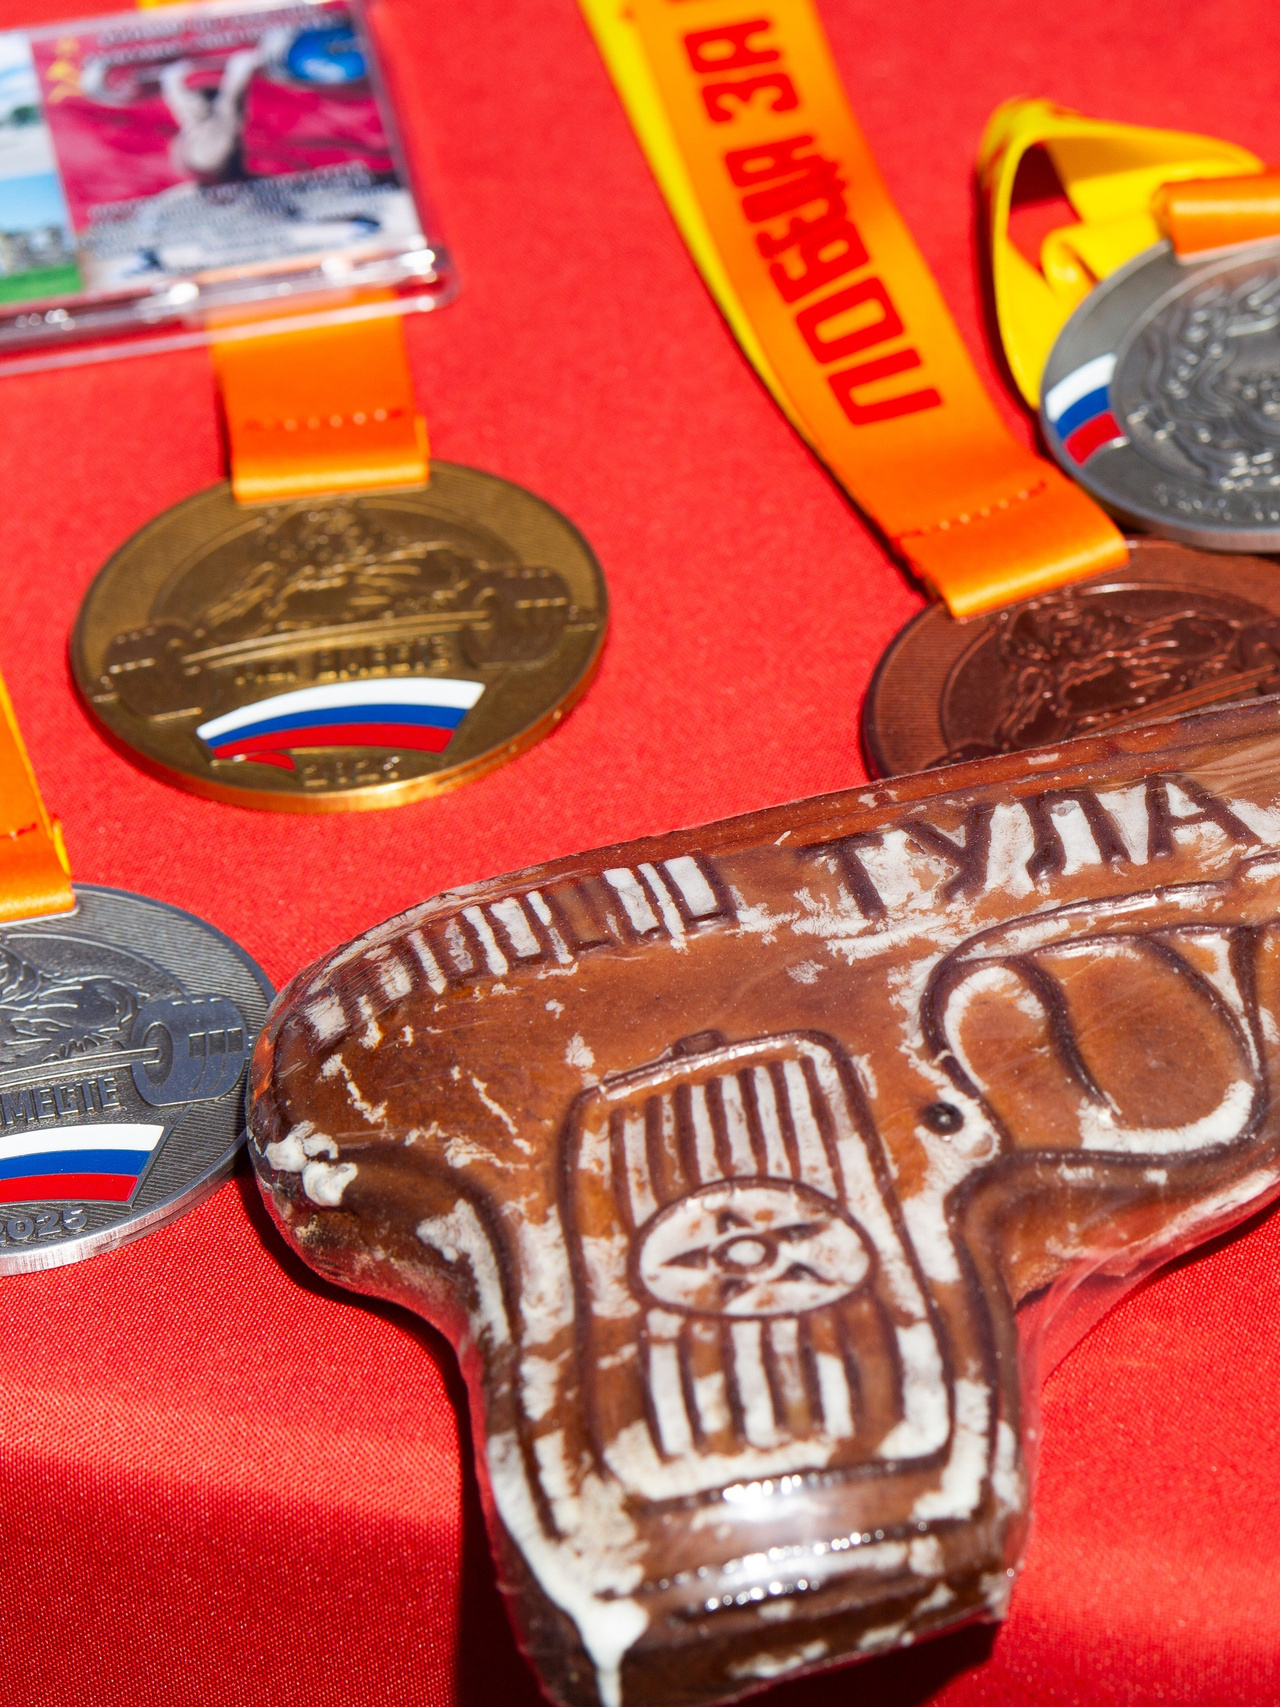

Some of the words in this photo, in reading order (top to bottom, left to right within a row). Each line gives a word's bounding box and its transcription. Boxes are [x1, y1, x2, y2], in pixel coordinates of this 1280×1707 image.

[685, 20, 799, 122] ЗА
[725, 135, 943, 427] ПОБЕДА
[799, 771, 1263, 920] ТУЛА
[0, 1076, 120, 1126] МЕСТЕ
